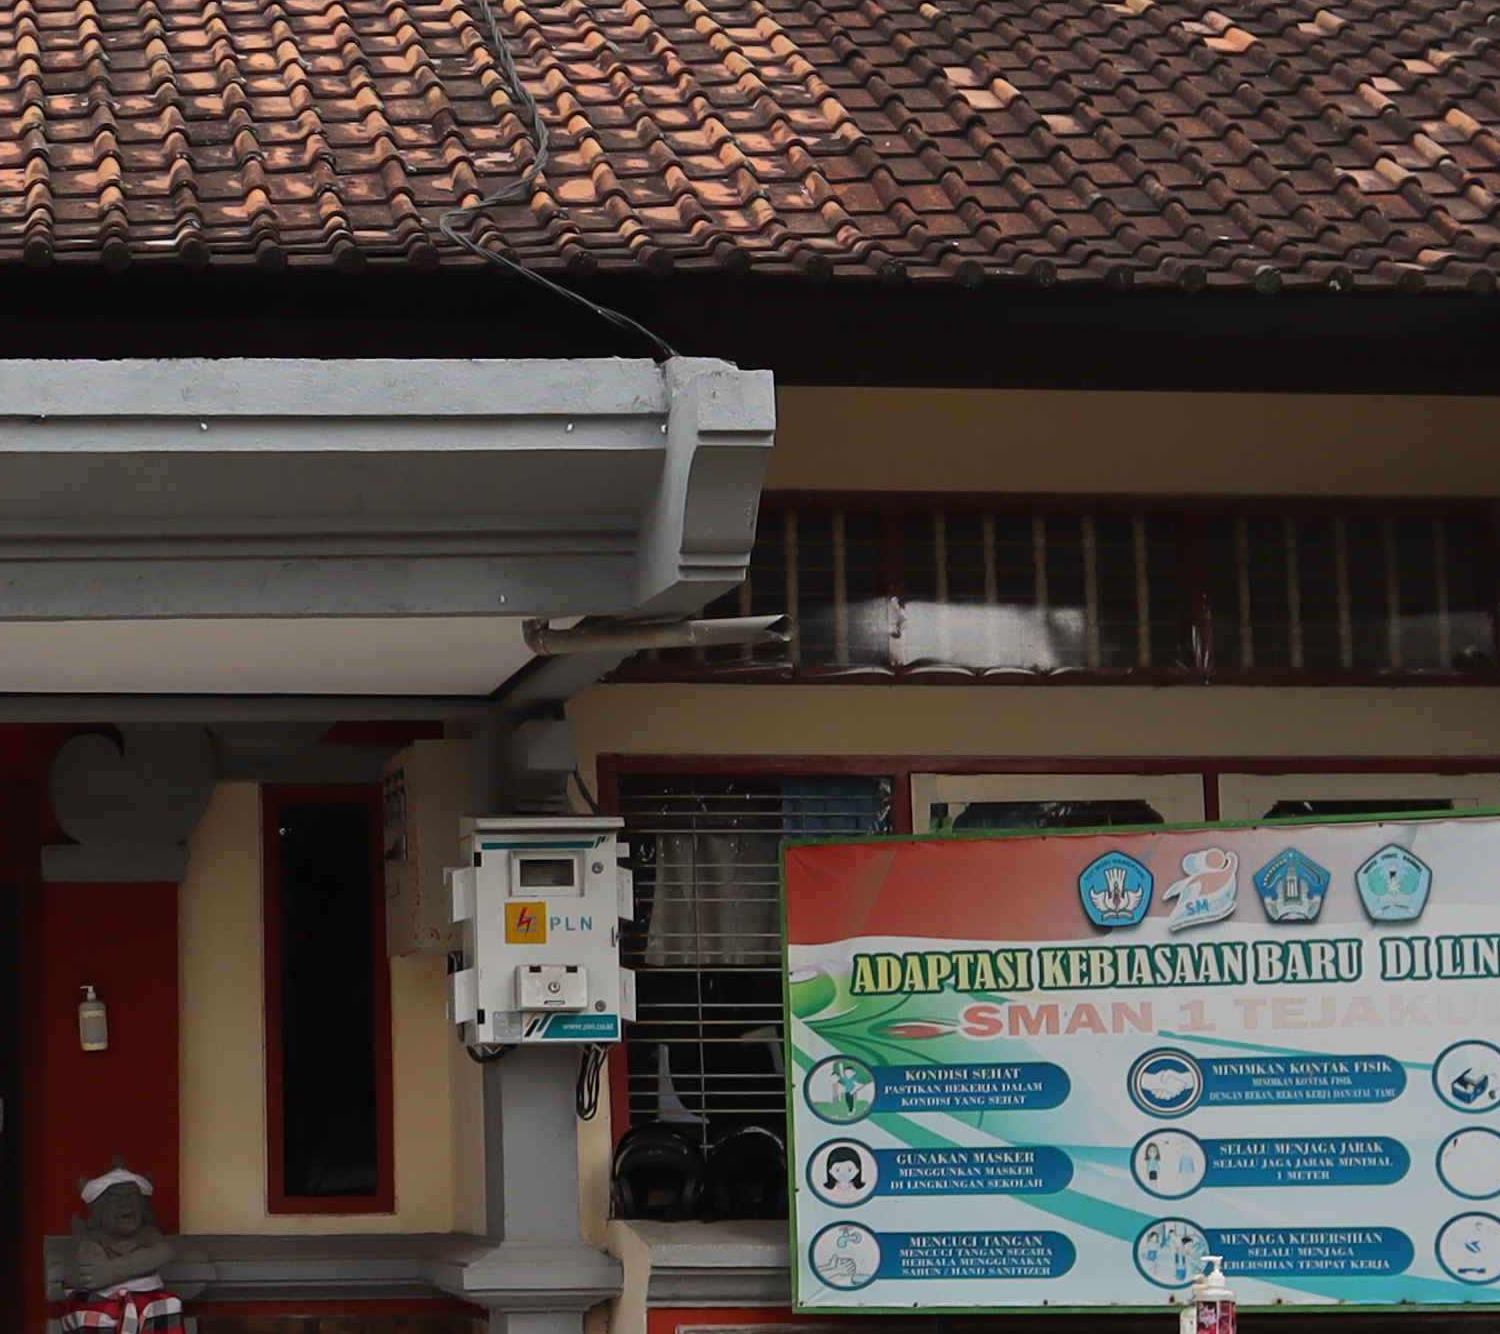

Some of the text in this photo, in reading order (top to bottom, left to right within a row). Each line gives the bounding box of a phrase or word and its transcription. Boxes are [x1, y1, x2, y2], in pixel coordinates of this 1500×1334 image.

[550, 916, 592, 931] PLN
[851, 949, 1032, 995] ADAPTASI
[1038, 942, 1248, 990] KEBIASAAN
[1252, 939, 1362, 982] BARU
[1380, 937, 1431, 980] DI
[961, 1002, 1154, 1037] SMAN
[1178, 999, 1216, 1032] 1
[1212, 1061, 1392, 1076] MINIMKAN KONTAK FISIK
[905, 1068, 1021, 1081] KONDISI SEHAT
[1295, 1077, 1328, 1086] KONTAK
[1331, 1076, 1352, 1085] FISIK
[884, 1083, 1042, 1094] PASTIKAN BEKERJA DALAM
[901, 1095, 1026, 1106] KONDISI YANG SEHAT
[1209, 1091, 1243, 1101] DENGAN
[1276, 1090, 1304, 1099] REKAN
[1305, 1089, 1332, 1099] KERJA
[1333, 1089, 1351, 1098] DAN
[1220, 1142, 1383, 1155] SELALU MENJAGA JARAK
[896, 1152, 1035, 1165] GUNAKAN MASKER
[1213, 1157, 1393, 1168] SELALU JAGA JARAK MINIMAL
[899, 1167, 1034, 1177] MENGGUNKAN MASKER
[1277, 1171, 1330, 1180] 1 METER
[890, 1179, 1043, 1190] DI LINGKUNGAN SEKOLAH
[910, 1236, 1042, 1247] MENCUCI TANGAN
[1220, 1232, 1383, 1245] MENJAGA KEBERSIHAN
[900, 1249, 953, 1257] MENCUCI
[1007, 1248, 1053, 1256] SECARA
[1248, 1247, 1355, 1257] SELALU MENJAGA
[902, 1257, 1051, 1266] BERKALA MENGGUNAKAN
[1223, 1259, 1390, 1270] EBERSIHAN TEMPAT KERJA
[902, 1268, 941, 1276] SABUN
[988, 1267, 1050, 1275] SANITIZER
